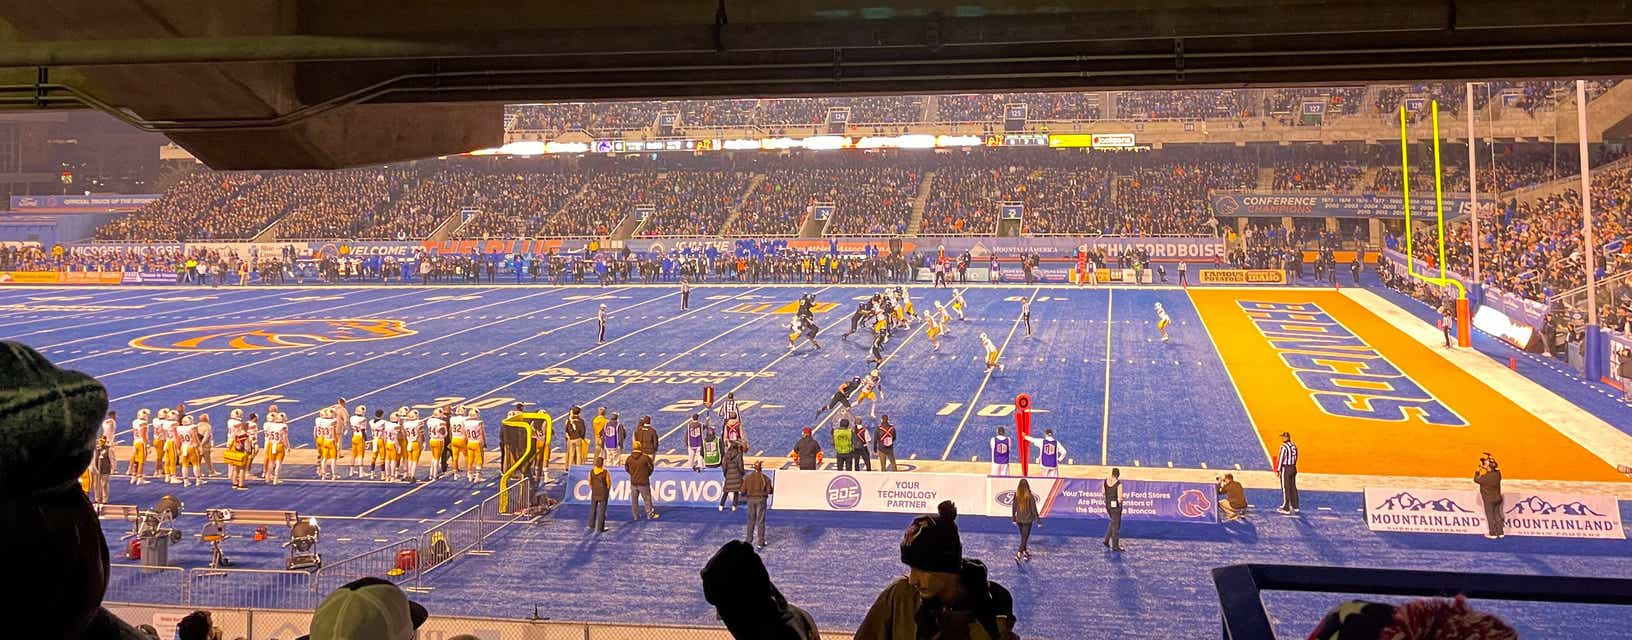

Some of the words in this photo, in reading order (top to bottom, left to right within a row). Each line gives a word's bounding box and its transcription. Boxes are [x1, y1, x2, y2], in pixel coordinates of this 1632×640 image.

[1243, 197, 1317, 206] CONFERENCE
[1234, 299, 1472, 428] BRONCOS
[934, 402, 1014, 416] 10
[895, 481, 920, 490] YOUR
[877, 490, 937, 499] TECHNOLOGY
[1130, 491, 1147, 499] Ford
[887, 500, 927, 509] PARTNER
[1372, 514, 1480, 527] MOUNTAINLAND
[1503, 518, 1613, 531] MOUNTAINLAND
